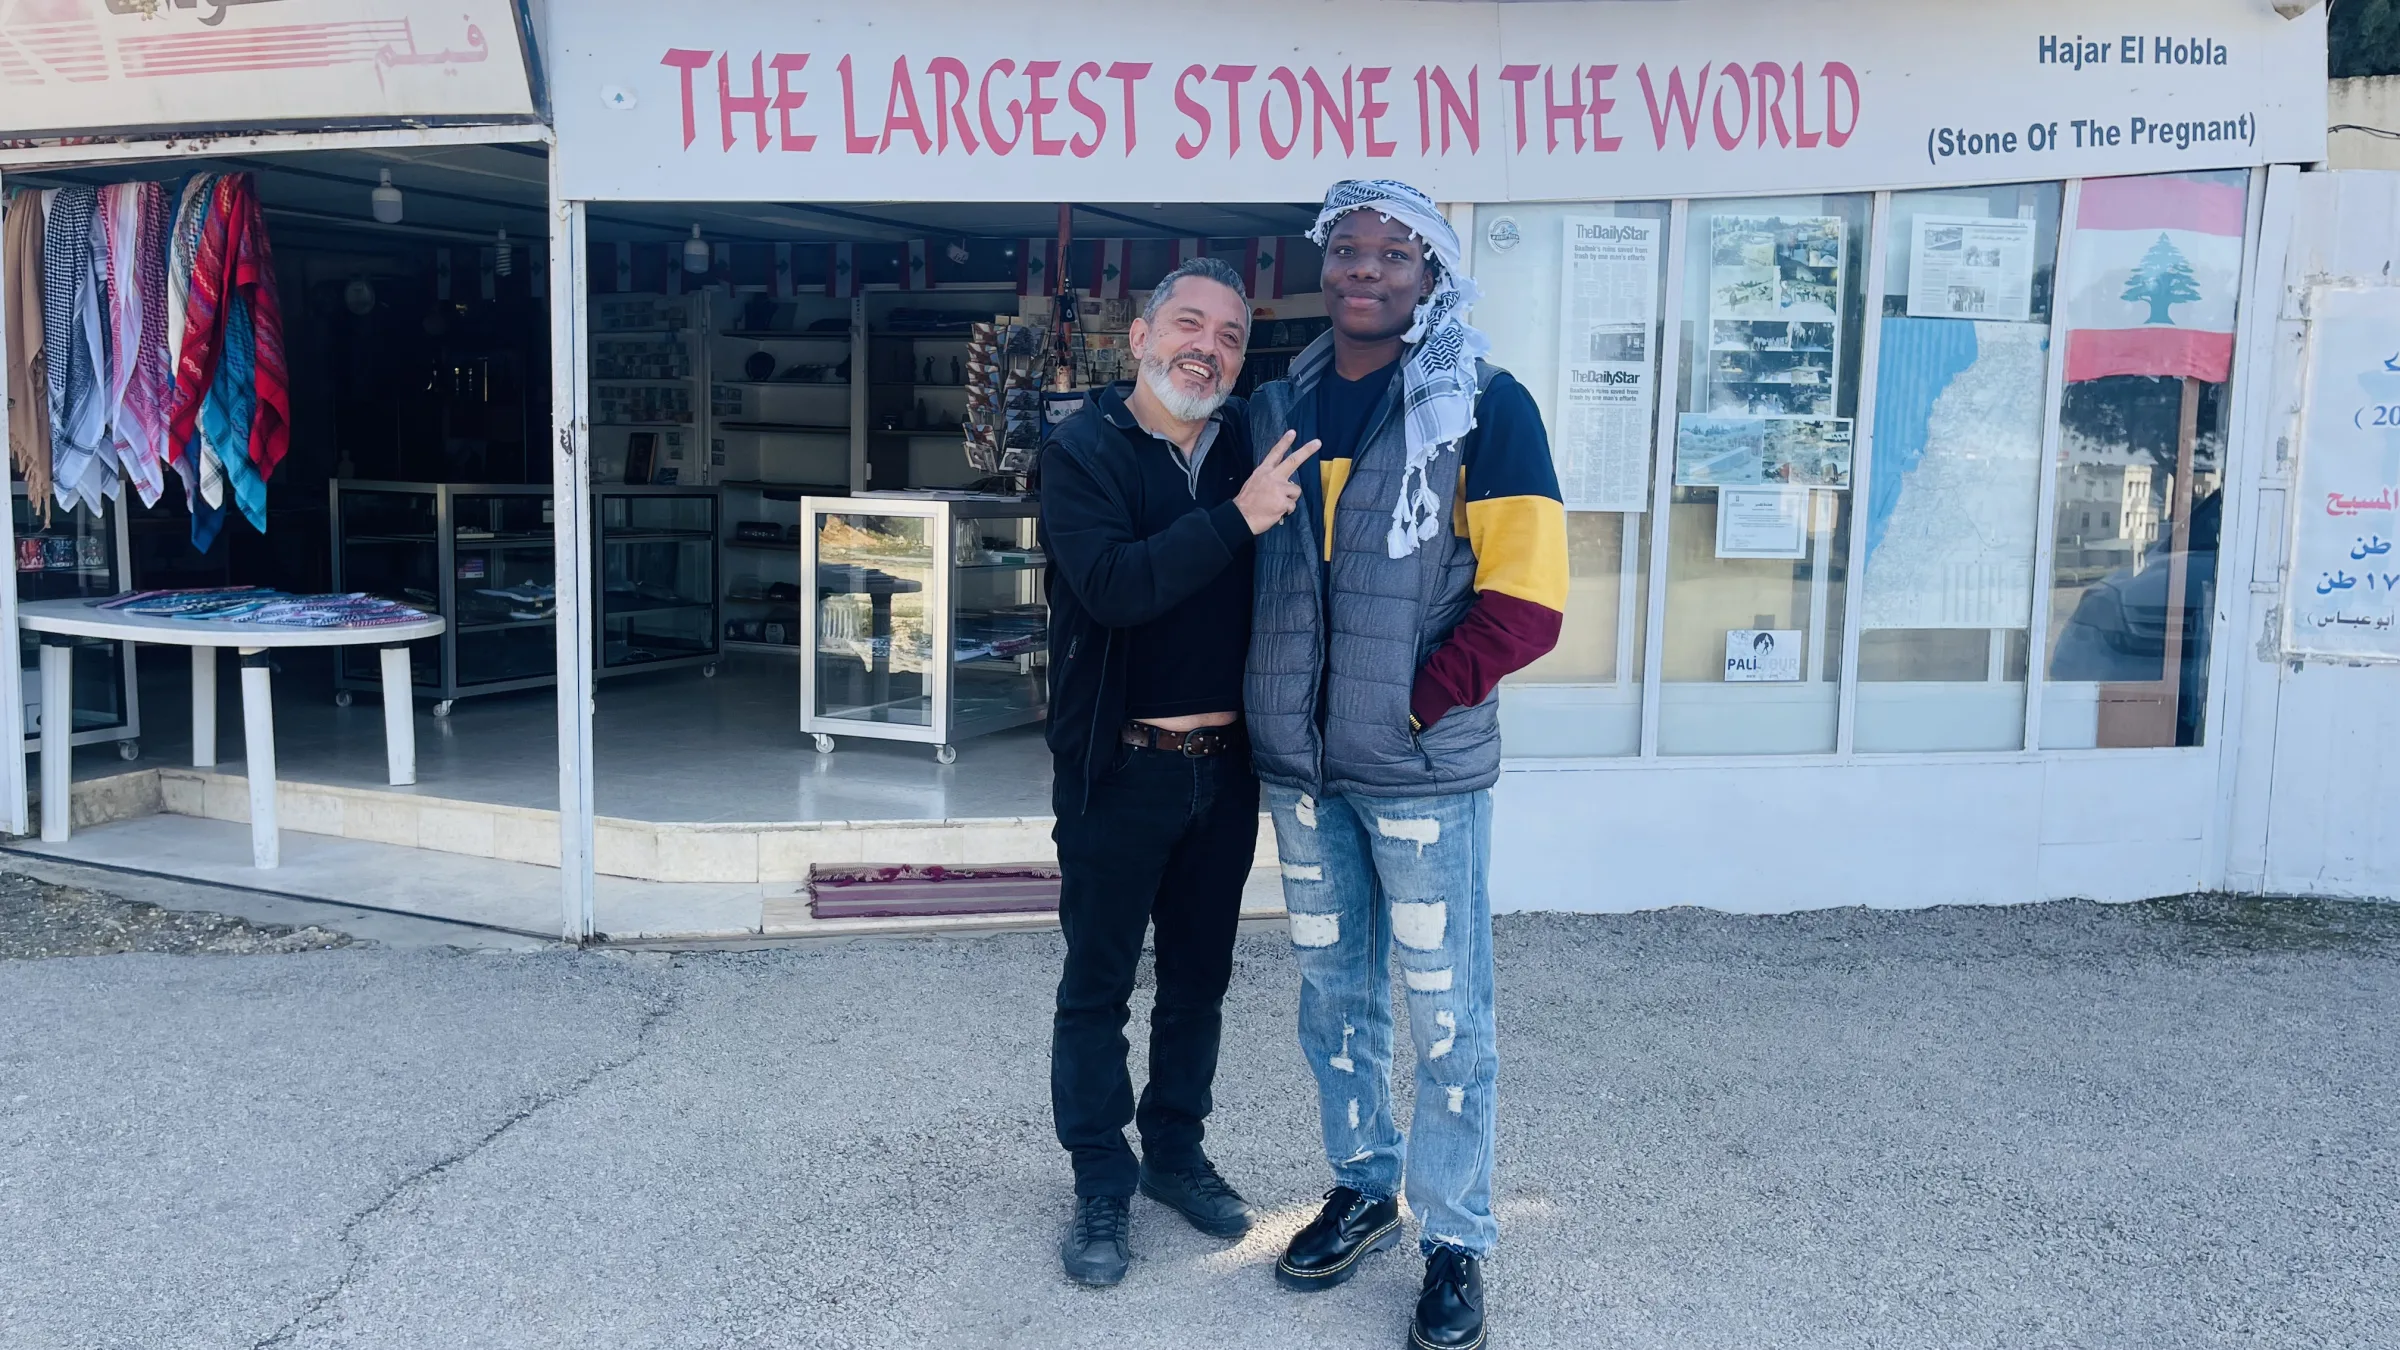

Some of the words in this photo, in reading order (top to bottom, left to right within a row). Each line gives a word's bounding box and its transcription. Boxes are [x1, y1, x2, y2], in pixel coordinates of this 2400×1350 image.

[373, 14, 489, 100] فيلم
[2039, 35, 2113, 73] Hajar
[2121, 36, 2145, 65] El
[2155, 36, 2229, 67] Hobla
[660, 48, 818, 153] THE
[836, 54, 1153, 159] LARGEST
[1174, 64, 1398, 161] STONE
[1413, 63, 1481, 156] IN
[1499, 63, 1624, 155] THE
[1636, 60, 1861, 152] WORLD
[1927, 128, 2019, 166] (Stone
[2028, 122, 2059, 153] Of
[2071, 119, 2122, 149] The
[2131, 112, 2257, 152] Pregnant)
[1634, 246, 1648, 254] from
[2326, 487, 2399, 516] المسيح
[2350, 535, 2392, 560] طن
[2316, 569, 2357, 595] طن
